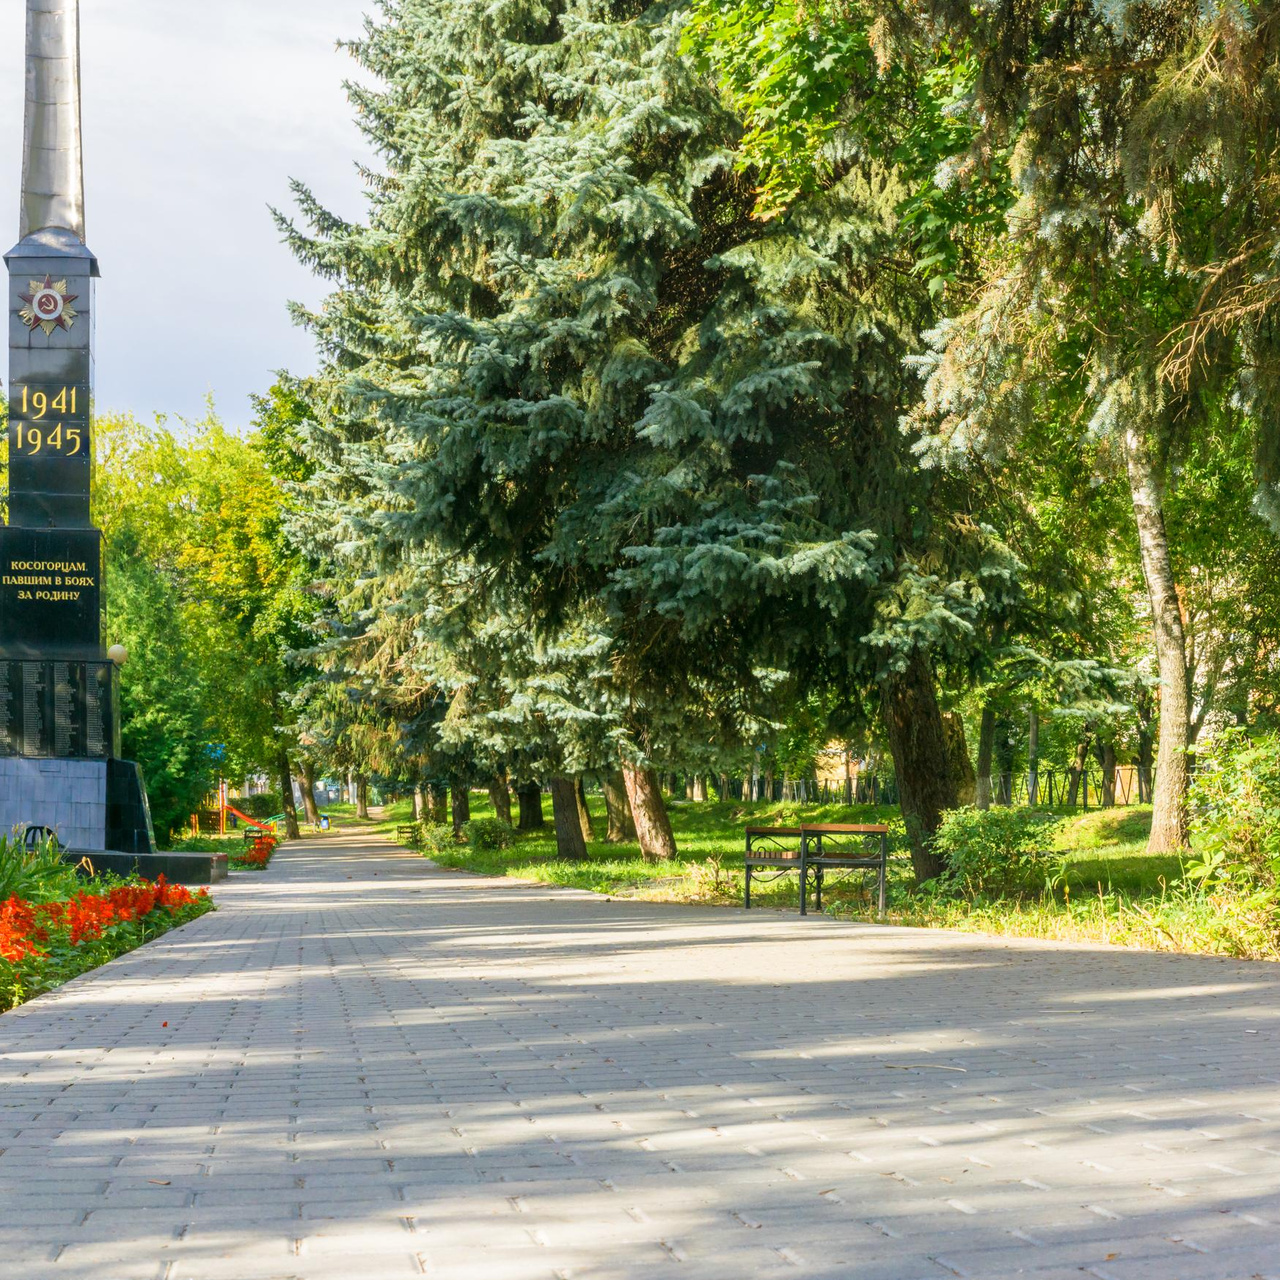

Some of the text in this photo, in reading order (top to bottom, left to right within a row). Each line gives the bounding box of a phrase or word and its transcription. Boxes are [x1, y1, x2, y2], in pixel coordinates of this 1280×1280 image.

[22, 385, 76, 420] 1941
[16, 422, 81, 456] 1945
[2, 575, 95, 586] ПАВШИМ В БОЯХ
[17, 590, 80, 601] ЗА РОДИНУ
